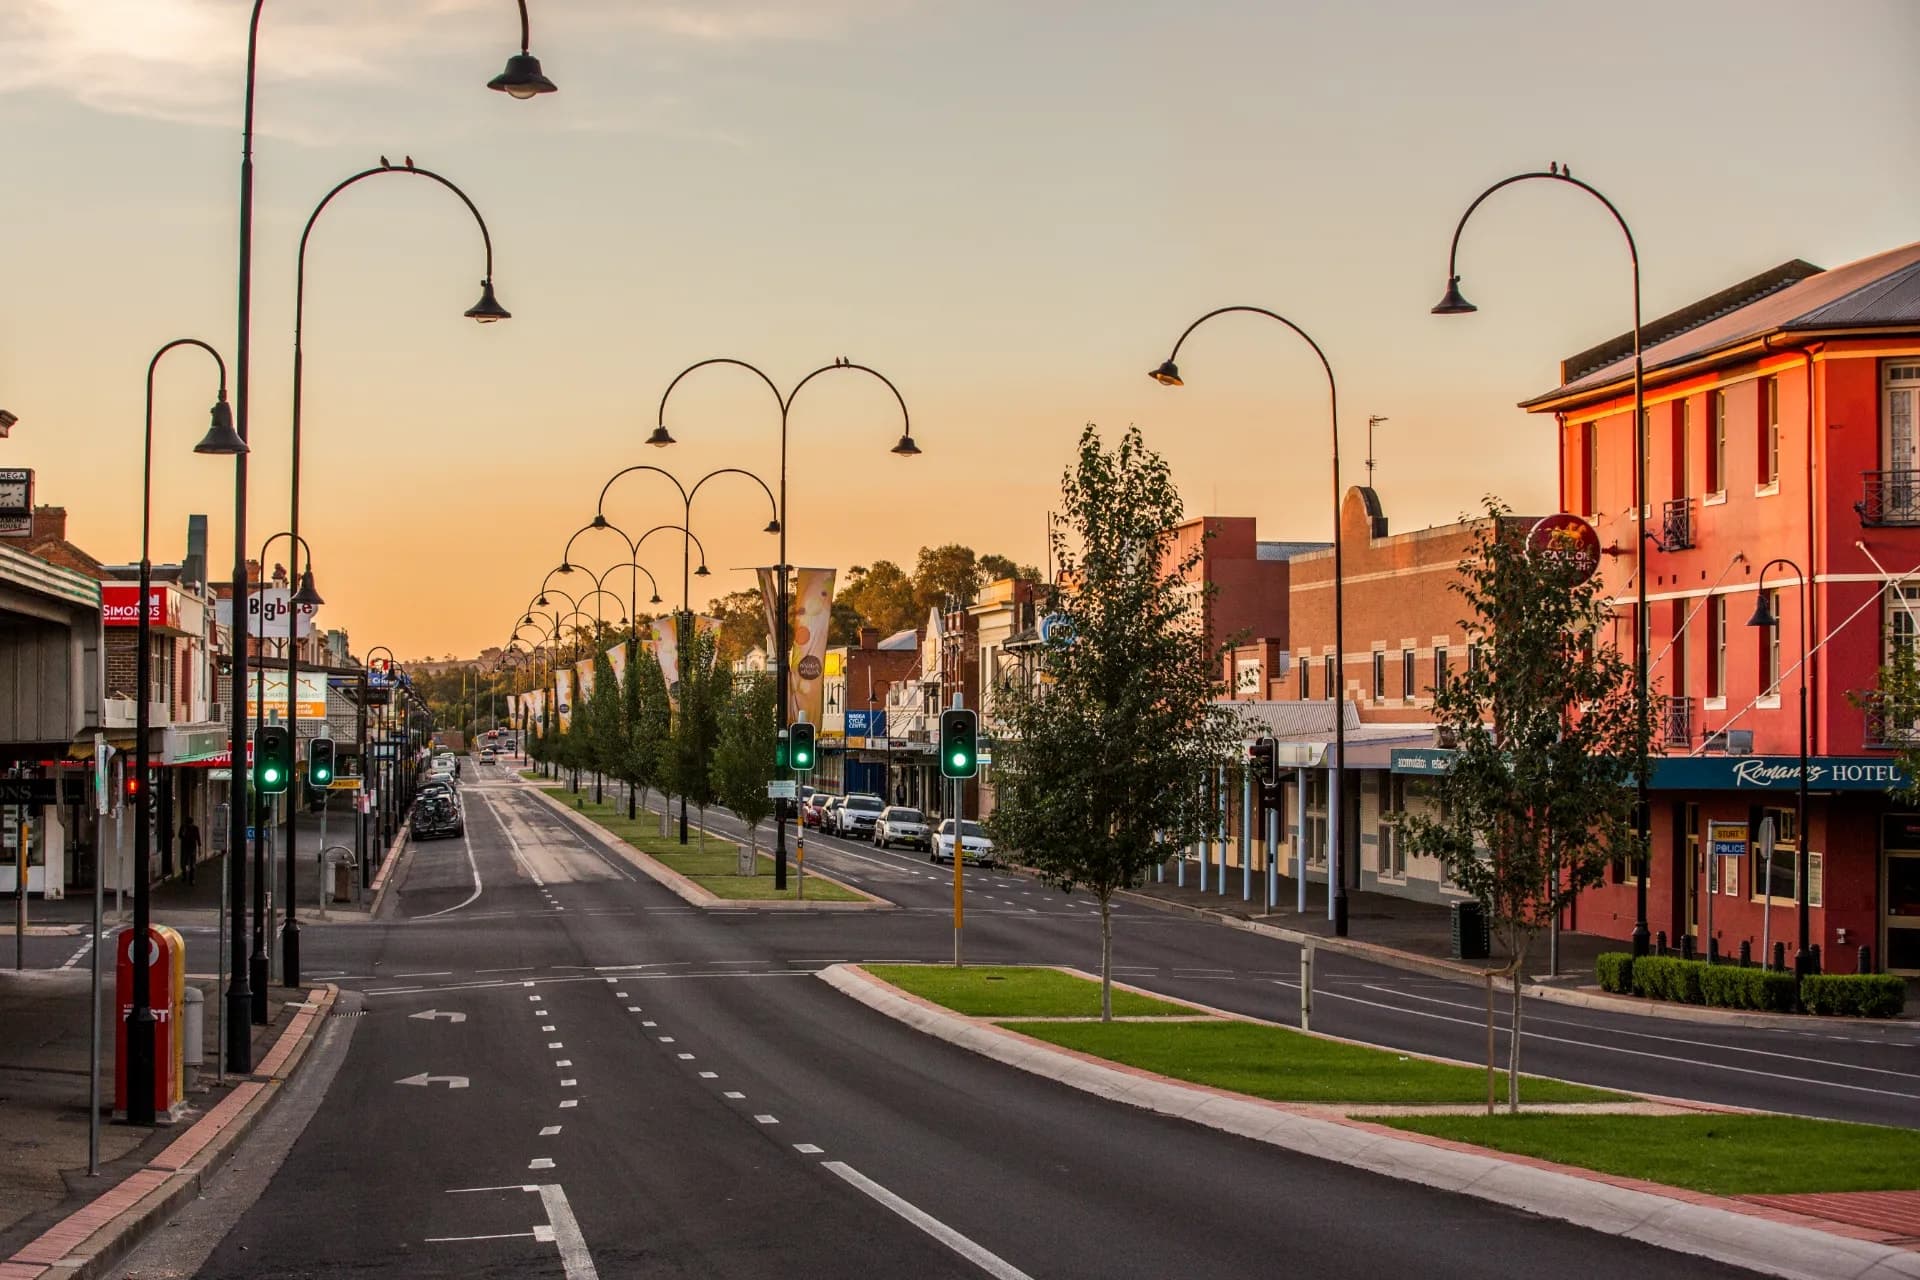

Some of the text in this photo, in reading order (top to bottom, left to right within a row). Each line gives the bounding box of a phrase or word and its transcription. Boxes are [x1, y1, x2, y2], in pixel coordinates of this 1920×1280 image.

[1732, 759, 1900, 787] Roman's HOTEL
[1717, 829, 1739, 838] STURT
[1715, 844, 1745, 853] POLICE
[123, 1008, 169, 1023] PST
